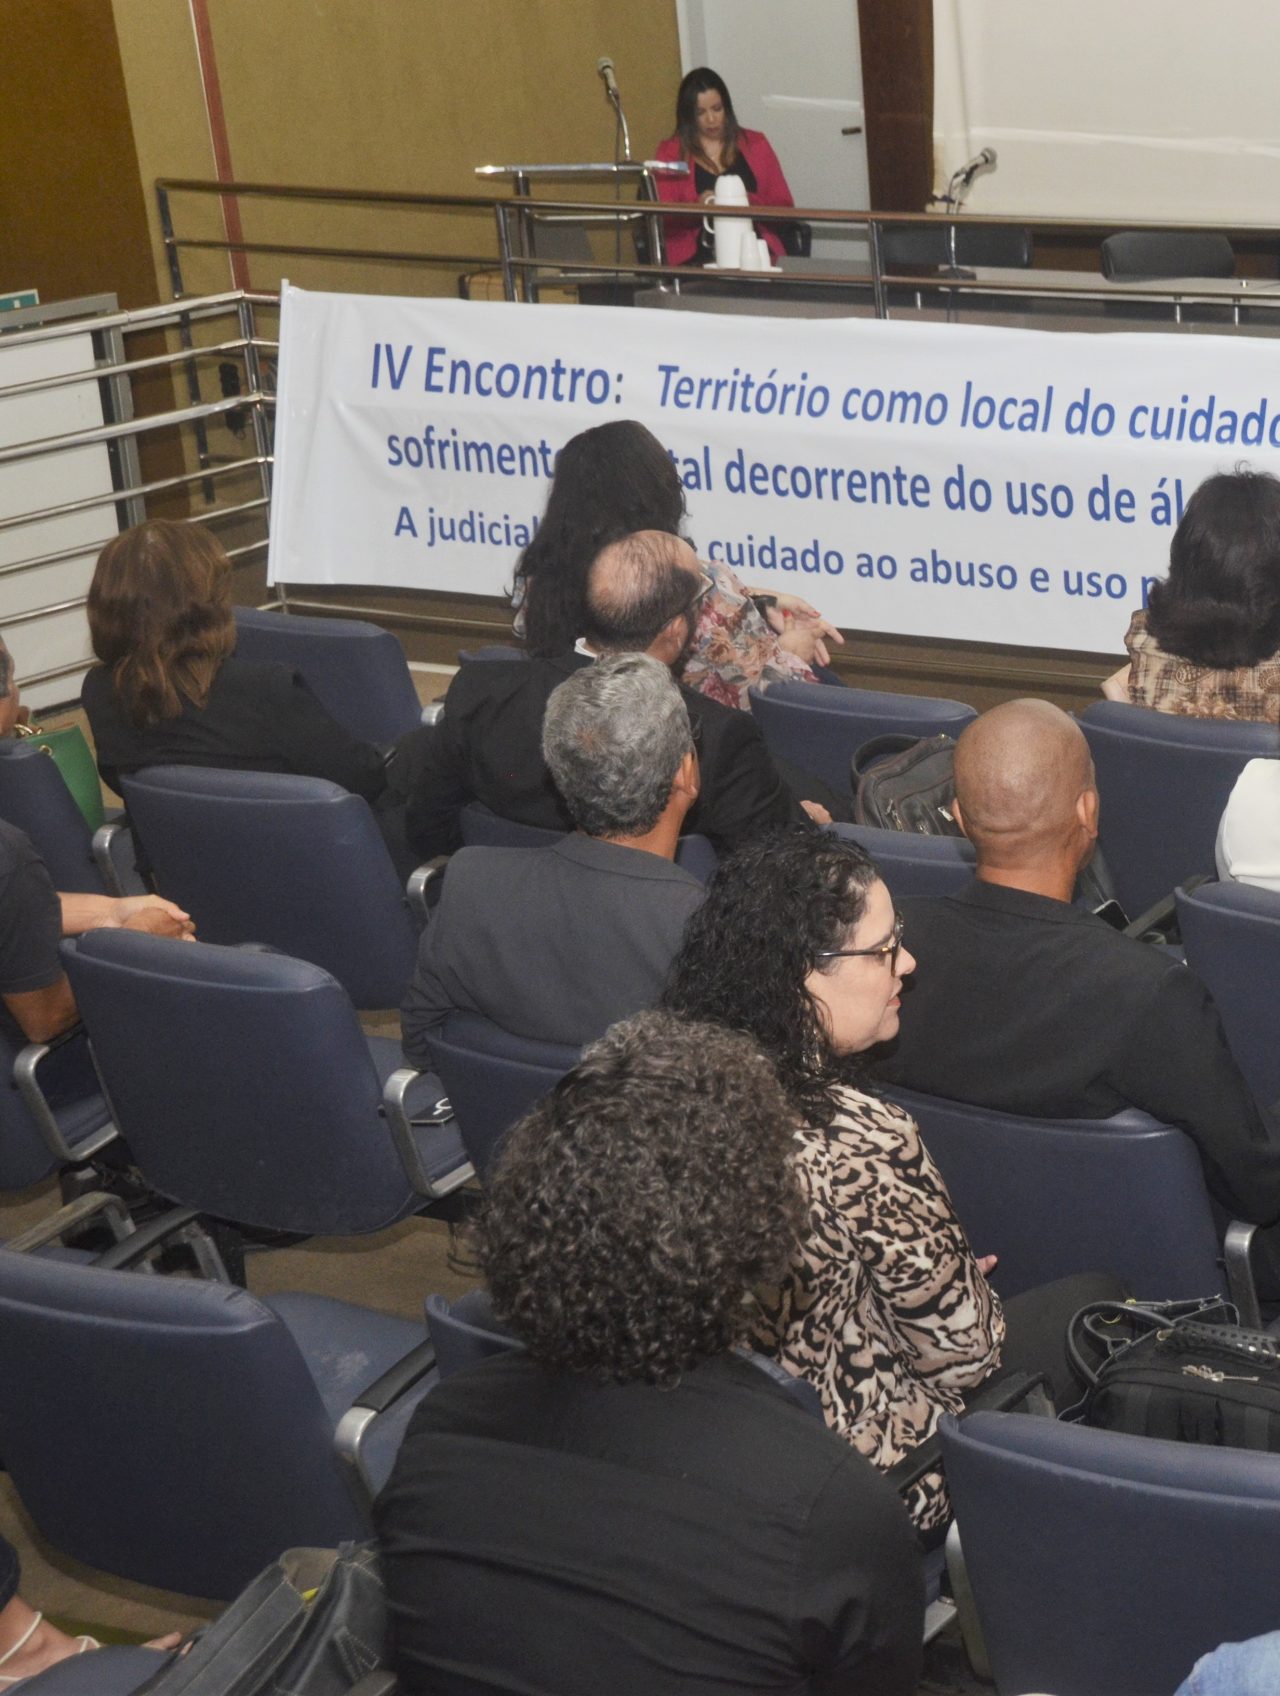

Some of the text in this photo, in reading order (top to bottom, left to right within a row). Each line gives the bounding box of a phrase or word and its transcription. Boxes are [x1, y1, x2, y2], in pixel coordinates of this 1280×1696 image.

[372, 344, 413, 390] IV
[425, 347, 624, 405] Encontro:
[658, 364, 830, 418] Território
[842, 387, 948, 427] como
[960, 381, 1054, 433] local
[1065, 388, 1116, 437] do
[387, 425, 562, 479] sofriment
[725, 450, 931, 508] decorrente
[944, 464, 993, 513] do
[1006, 481, 1074, 519] uso
[1088, 473, 1136, 524] de
[394, 506, 418, 538] A
[708, 536, 845, 576] cuidado
[856, 553, 898, 581] ao
[909, 550, 1018, 590] abuso
[1030, 567, 1050, 593] e
[1063, 569, 1128, 600] uso
